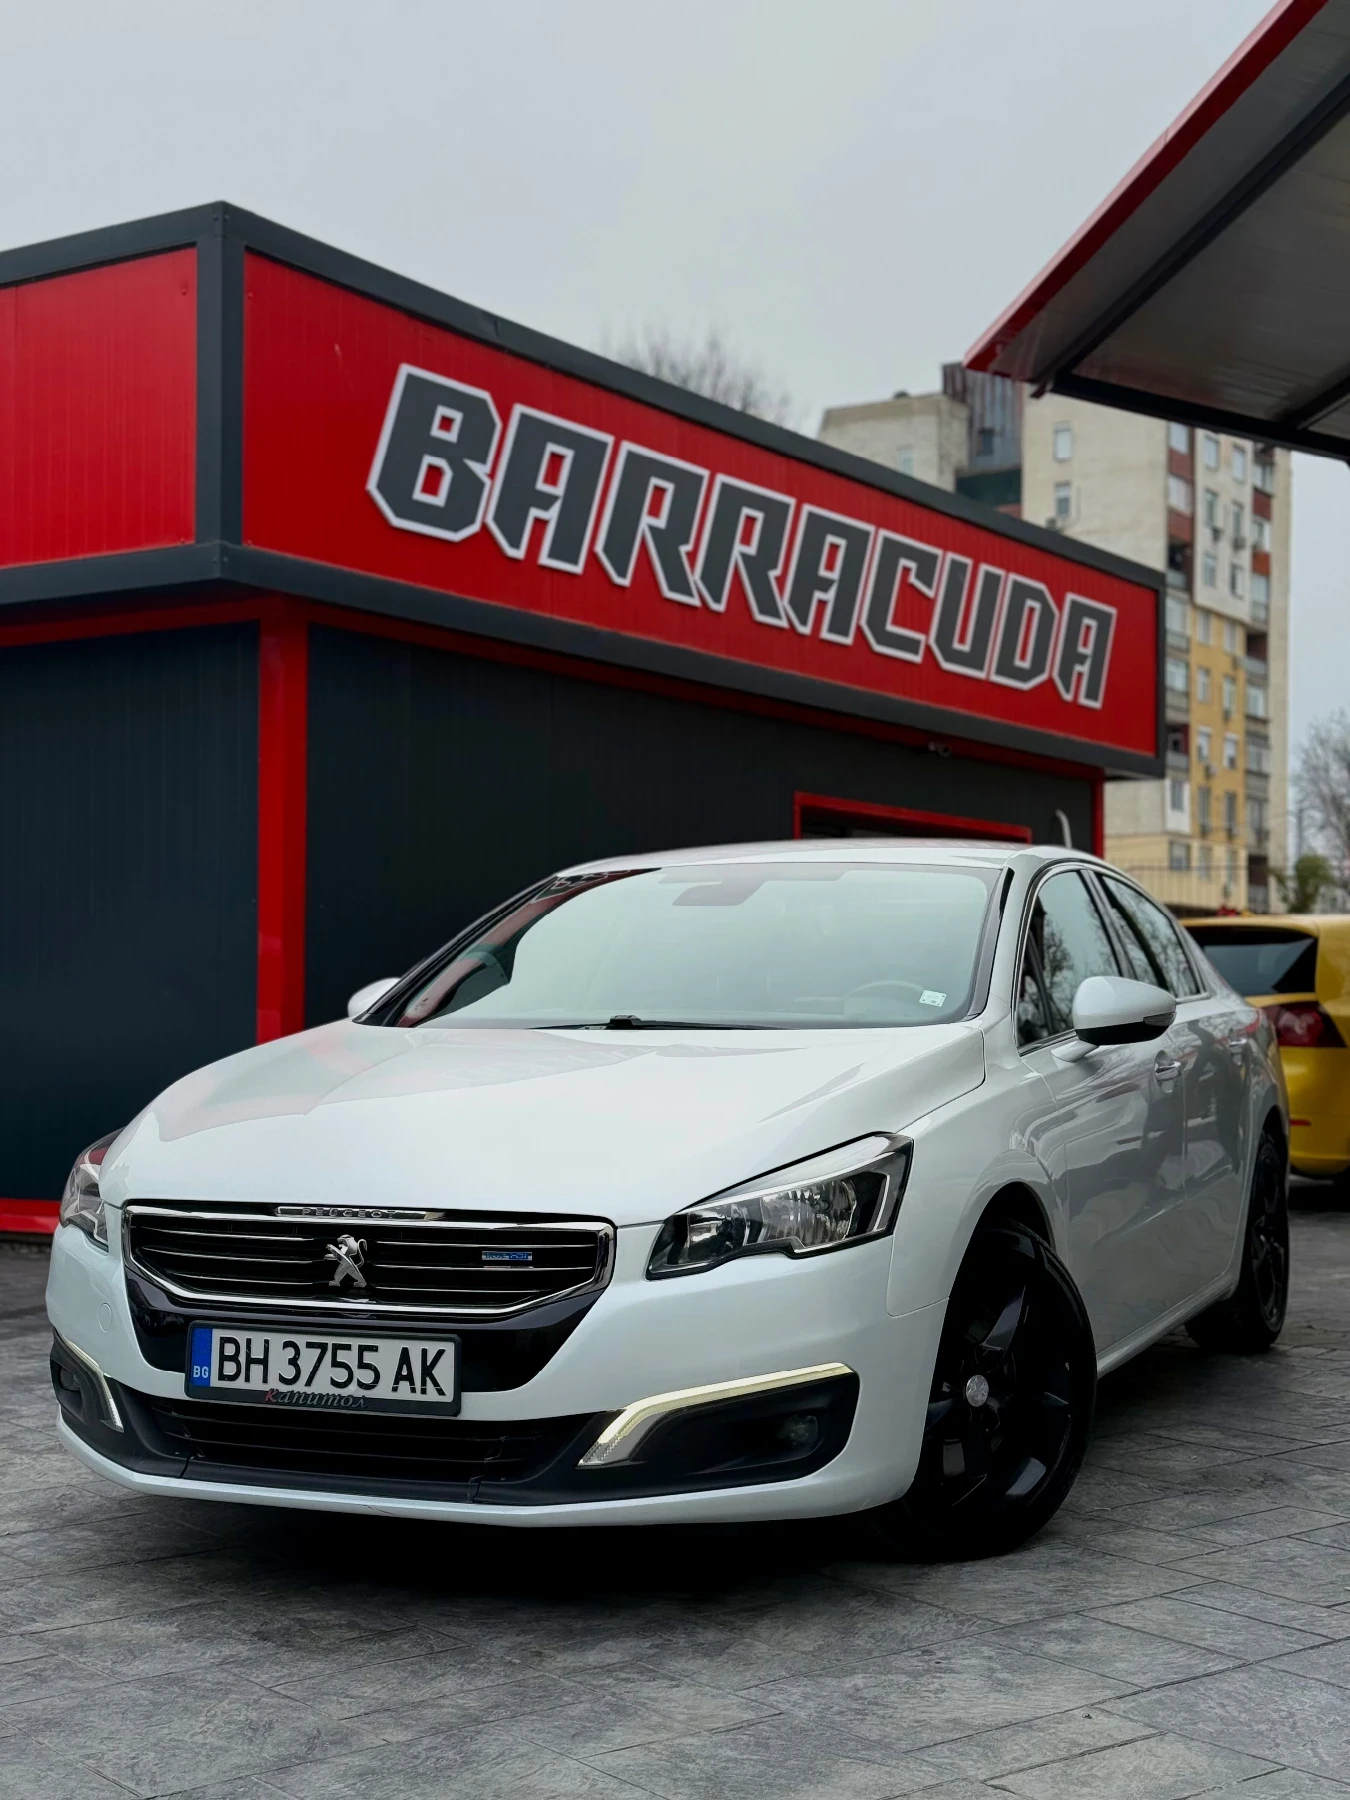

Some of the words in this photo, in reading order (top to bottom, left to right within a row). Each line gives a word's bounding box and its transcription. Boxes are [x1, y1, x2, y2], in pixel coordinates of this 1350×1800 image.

[366, 363, 1117, 709] BARRACUDA
[302, 1207, 396, 1218] PEUGEOT
[193, 1365, 209, 1379] BG
[217, 1336, 270, 1384] BH
[278, 1340, 381, 1390] 3755
[391, 1346, 447, 1396] AK
